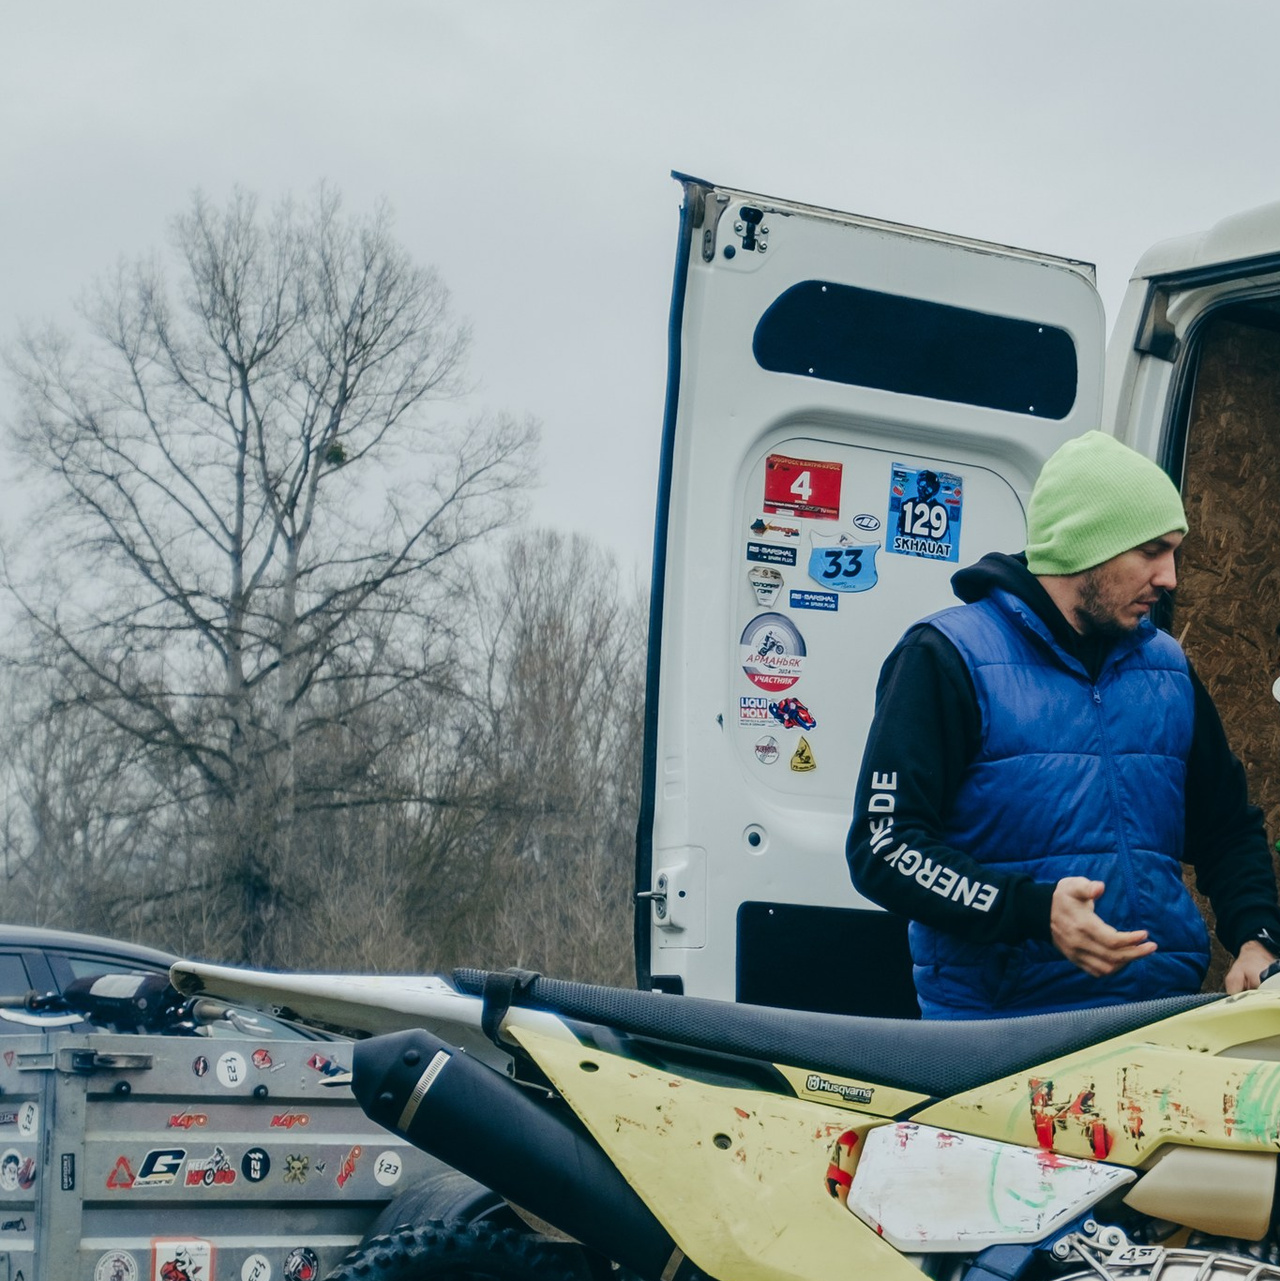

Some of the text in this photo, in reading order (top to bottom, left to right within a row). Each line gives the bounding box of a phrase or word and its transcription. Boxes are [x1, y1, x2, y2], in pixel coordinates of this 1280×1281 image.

[790, 470, 812, 501] 4
[903, 501, 948, 538] 129
[894, 537, 951, 556] SKHAUAT
[822, 549, 864, 579] 33
[745, 654, 802, 667] АРМАНЬЯК
[754, 675, 794, 685] УЧАСТНИК
[741, 697, 767, 708] LIQUI
[741, 708, 768, 719] MOLY
[883, 843, 1000, 912] ENERGY
[819, 1080, 873, 1098] Husqvarna
